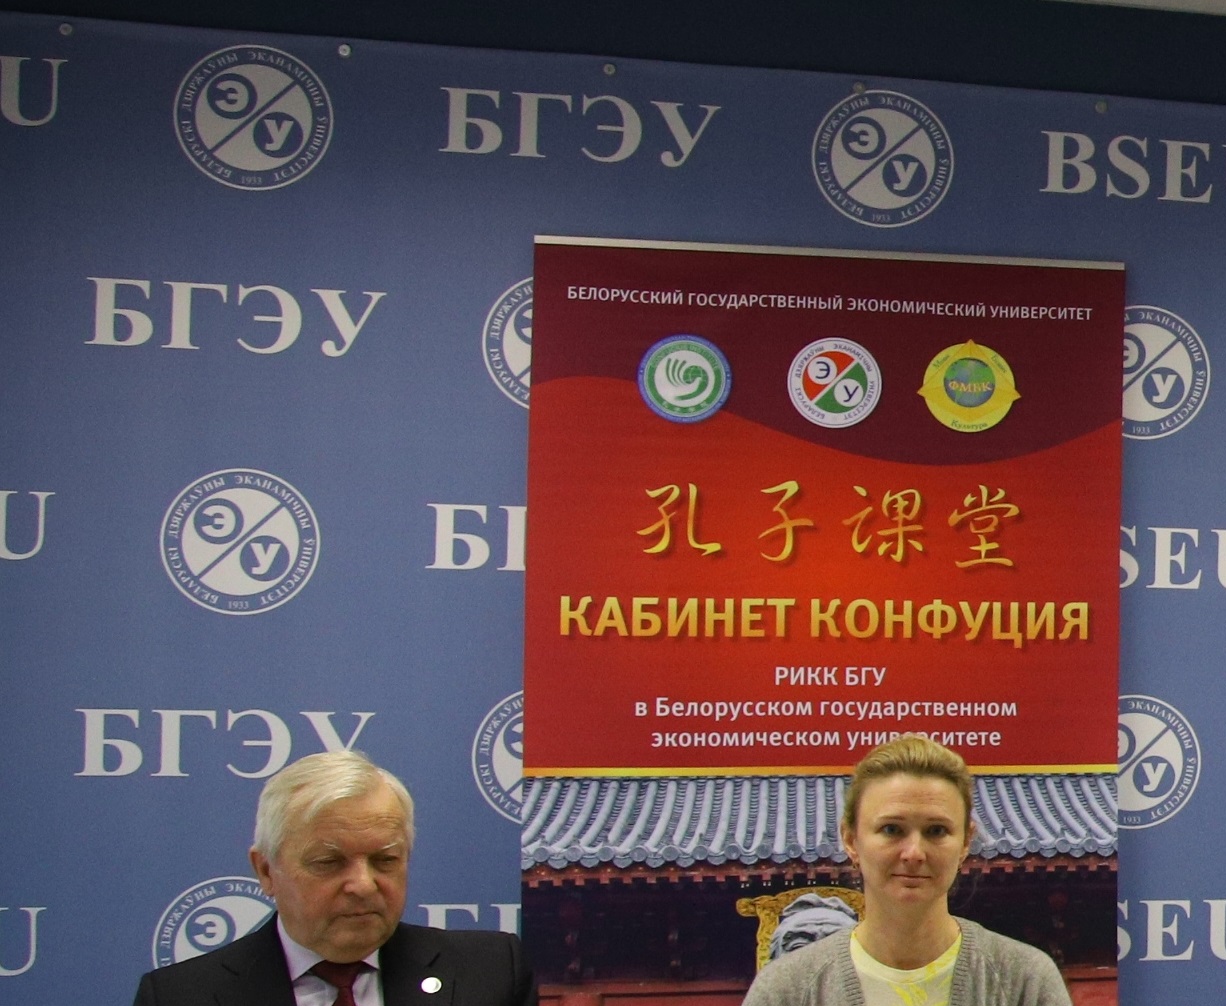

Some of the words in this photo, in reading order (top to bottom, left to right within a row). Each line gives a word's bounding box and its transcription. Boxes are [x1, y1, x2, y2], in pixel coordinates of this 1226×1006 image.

[439, 87, 721, 167] БГЭУ
[85, 277, 387, 357] БГЭУ
[567, 286, 683, 305] БЕЛОРУССКИЙ
[688, 292, 843, 310] ГОСУДАРСТВЕННЫЙ
[847, 298, 986, 318] ЭКОНОМИЧЕСКИЙ
[990, 305, 1093, 321] УНИВЕРСИТЕТ
[816, 361, 830, 379] Э
[948, 380, 993, 392] ФМБК
[843, 384, 859, 402] У
[168, 477, 226, 538] ДЗЯРЖАЎНЫ
[235, 476, 311, 530] ЭКАНАМІЧНЫ
[636, 480, 1020, 568] 孔子课堂
[168, 547, 219, 604] БЕЛАРУСКІ
[261, 538, 314, 606] ЎНІВЕРСІТЭТ
[228, 601, 249, 609] 1933
[559, 595, 796, 638] КАБИНЕТ
[810, 597, 1090, 649] КОНФУЦИЯ
[774, 666, 838, 686] РИКК
[845, 667, 886, 686] БГУ
[634, 703, 648, 717] в
[655, 698, 812, 721] Белорусском
[819, 700, 1018, 720] государственном
[650, 730, 841, 748] экономическом
